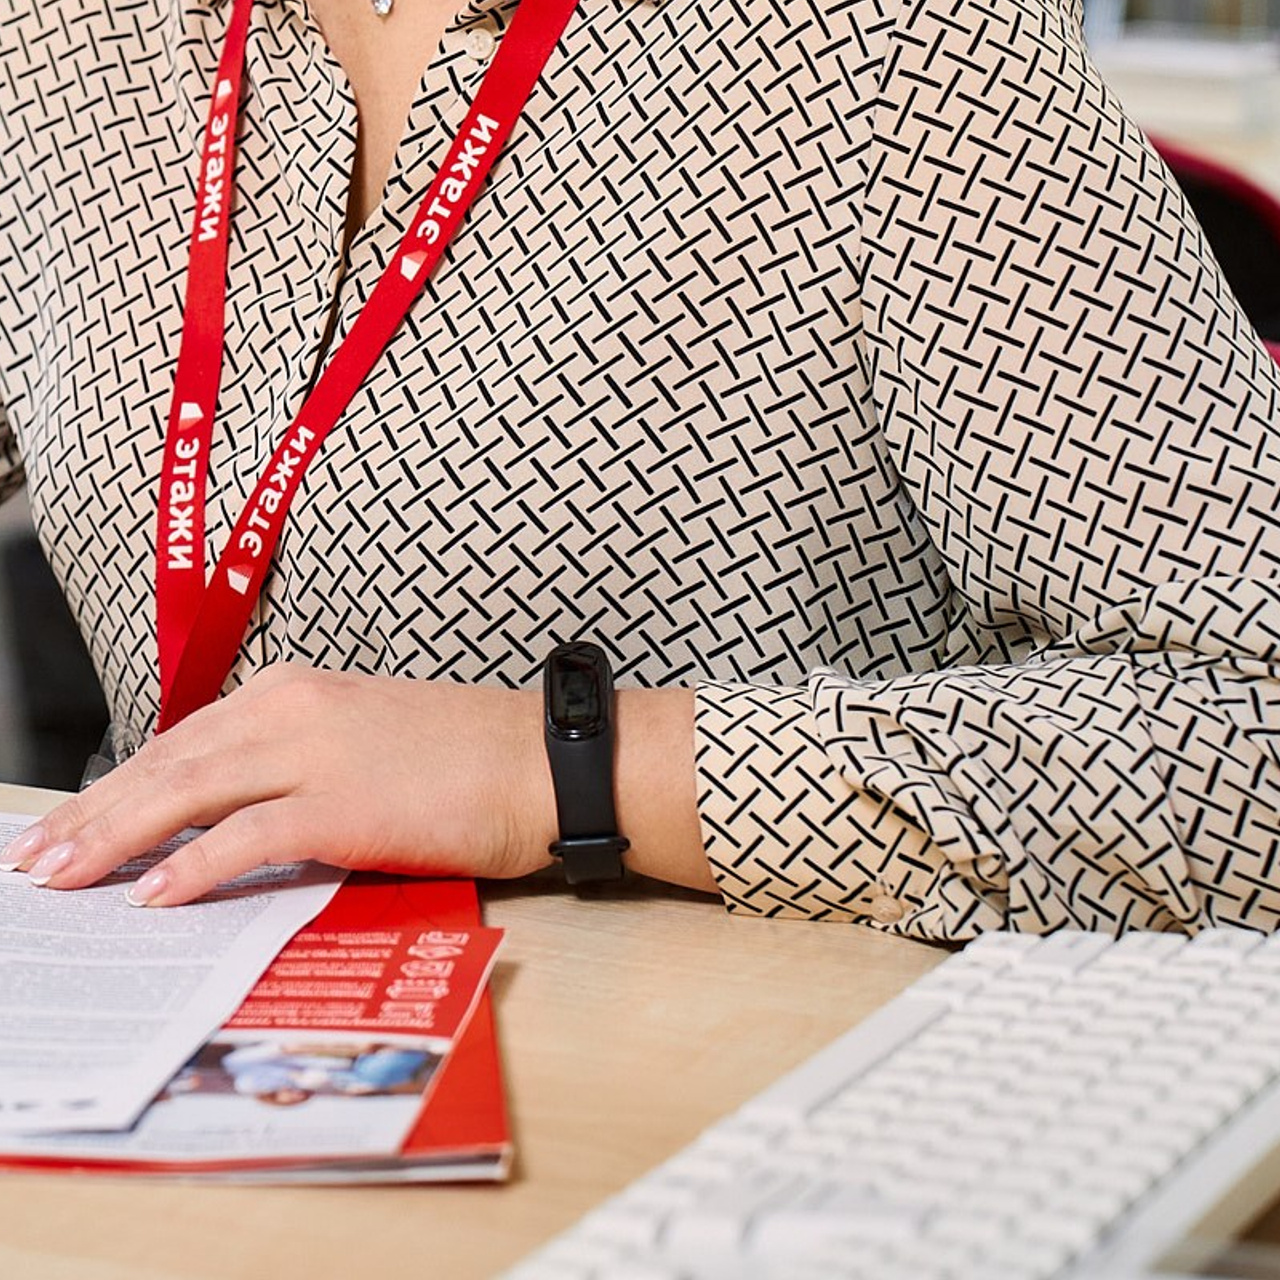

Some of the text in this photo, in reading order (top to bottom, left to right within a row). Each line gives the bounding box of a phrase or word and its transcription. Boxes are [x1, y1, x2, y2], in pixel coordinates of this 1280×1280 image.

[199, 113, 229, 242] этажи
[416, 114, 500, 245] этажи
[167, 437, 200, 569] этажи
[239, 425, 315, 558] этажи
